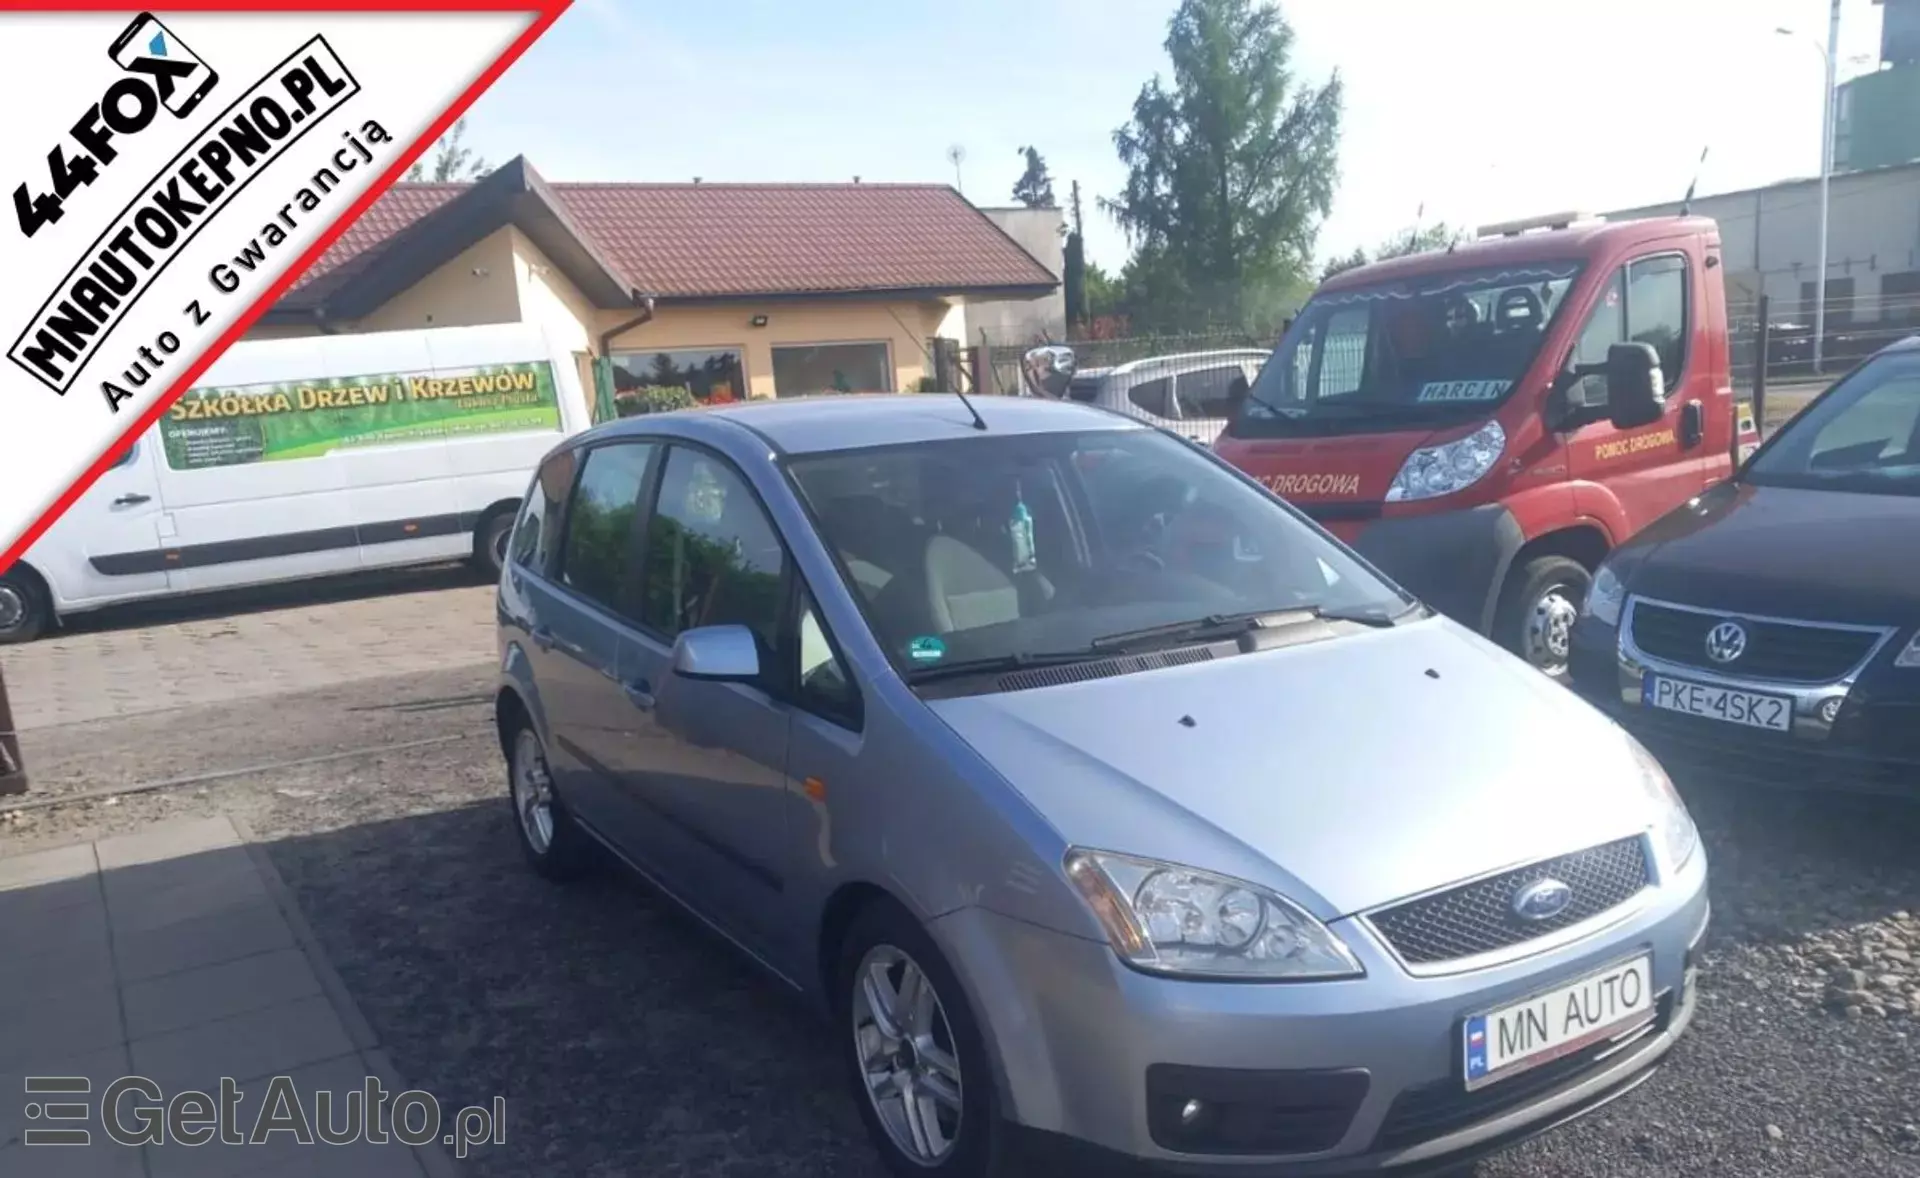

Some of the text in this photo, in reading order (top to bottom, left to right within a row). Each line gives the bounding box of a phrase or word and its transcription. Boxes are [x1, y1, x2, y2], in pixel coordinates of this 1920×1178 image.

[170, 389, 292, 421] SZKÓŁKA
[299, 384, 388, 411] DRZEW
[411, 370, 535, 399] KRZEWÓW
[1423, 381, 1506, 399] MARCIN
[1594, 428, 1675, 460] POMOC DROGOWA
[1271, 474, 1360, 495] DROGOWA
[1498, 968, 1641, 1059] MN AUTO
